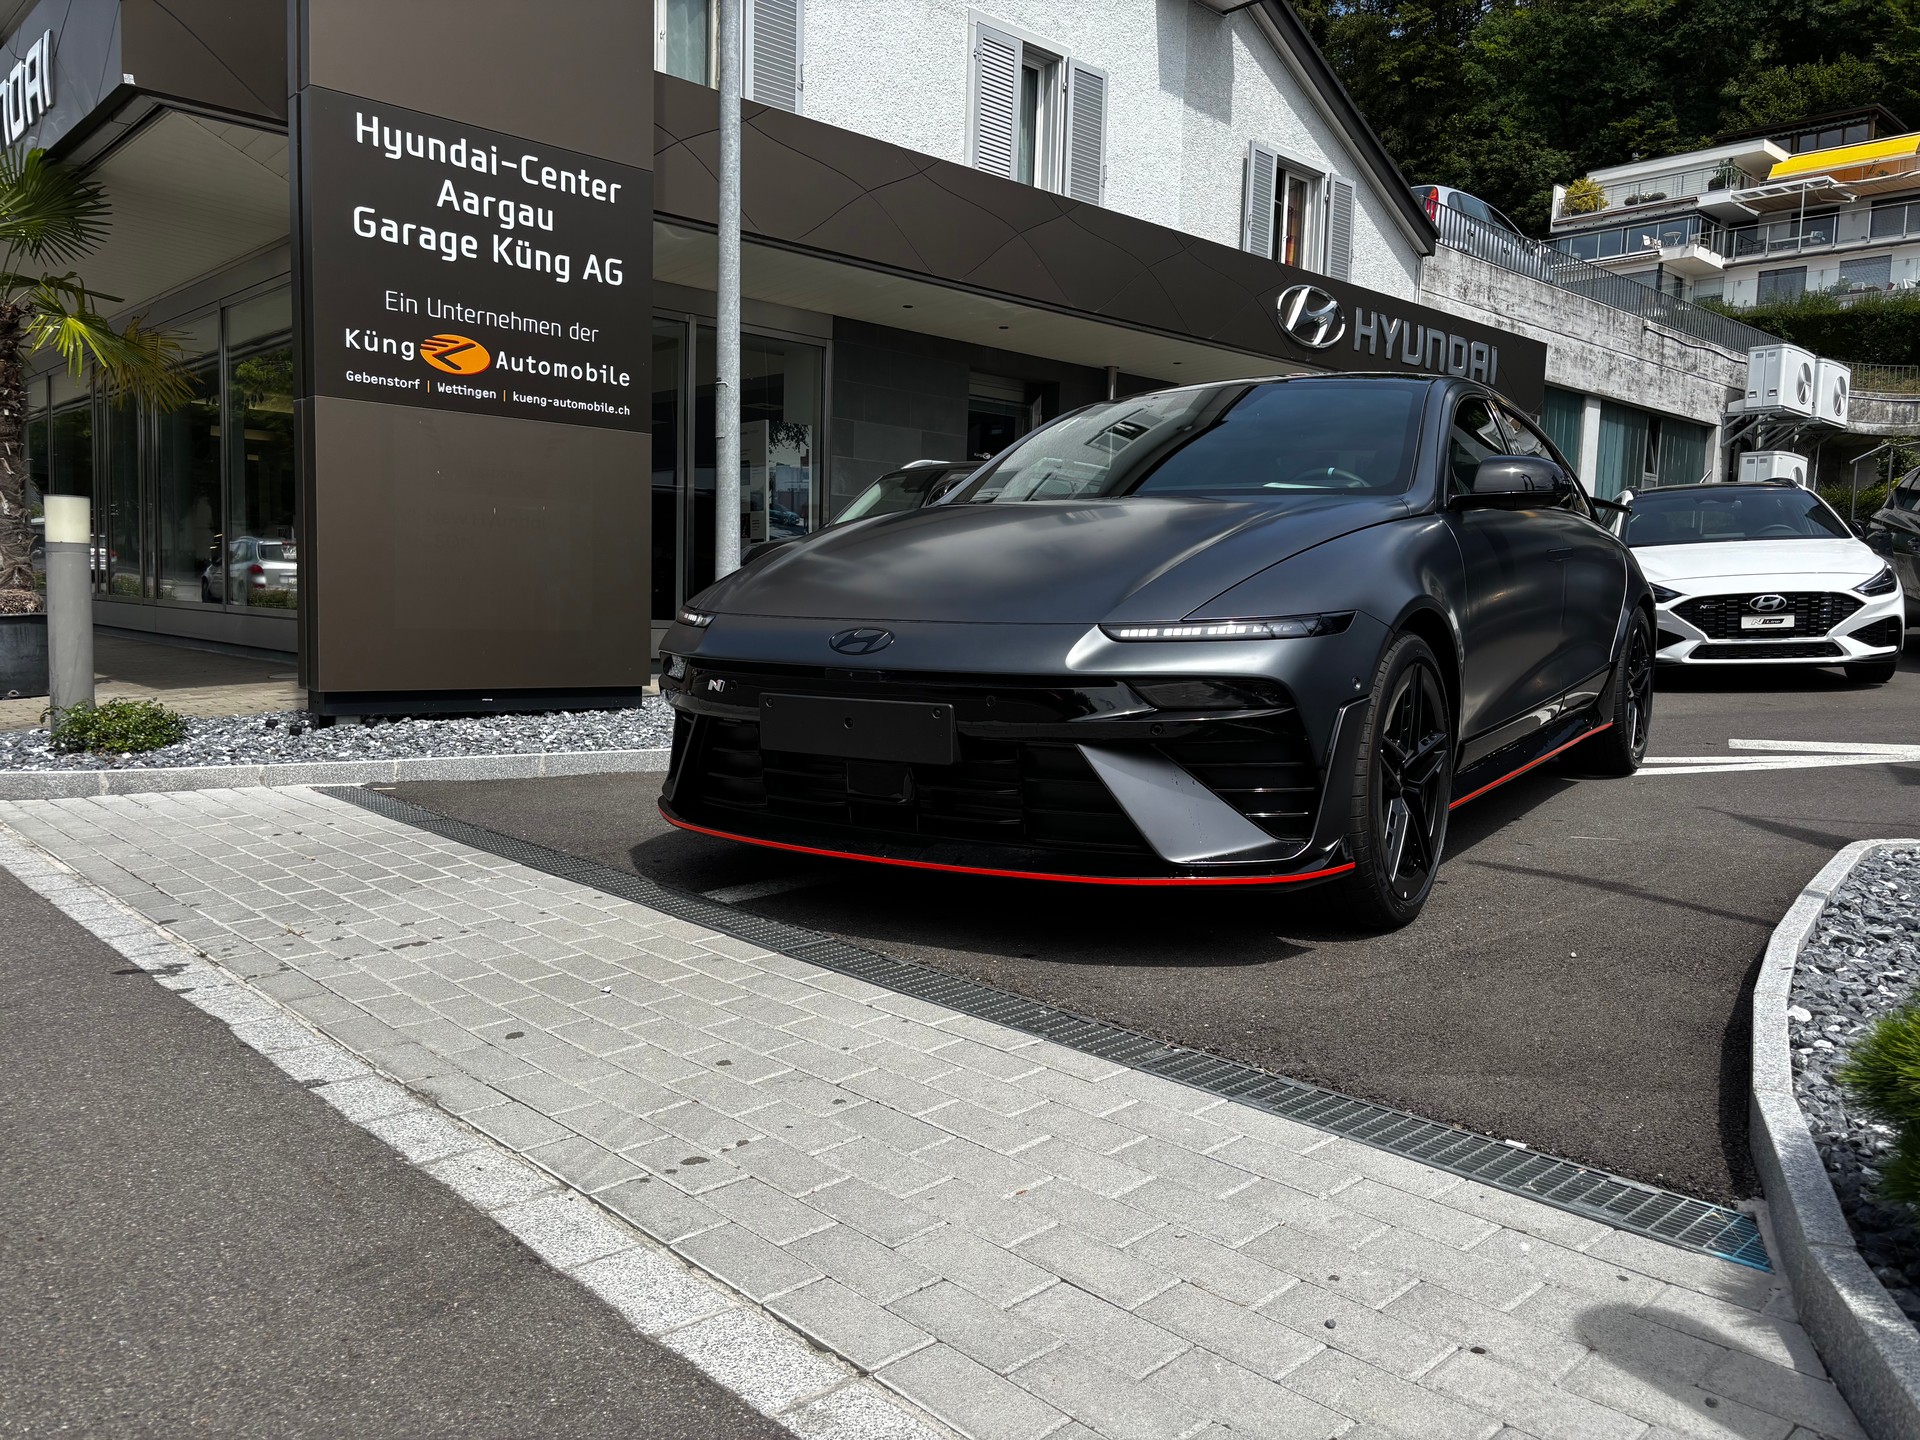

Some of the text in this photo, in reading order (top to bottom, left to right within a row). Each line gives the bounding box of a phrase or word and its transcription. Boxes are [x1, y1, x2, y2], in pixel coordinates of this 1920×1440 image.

[355, 111, 622, 204] Hyundai-Center
[436, 179, 554, 232] Aargau
[353, 205, 623, 286] Garage Küng AG
[385, 289, 599, 343] Ein Unternehmen der
[1353, 306, 1498, 385] HYUNDAI
[345, 327, 631, 387] Küng Automobile
[346, 370, 631, 416] Gebenstorf Wettingen kueng-automobile.ch
